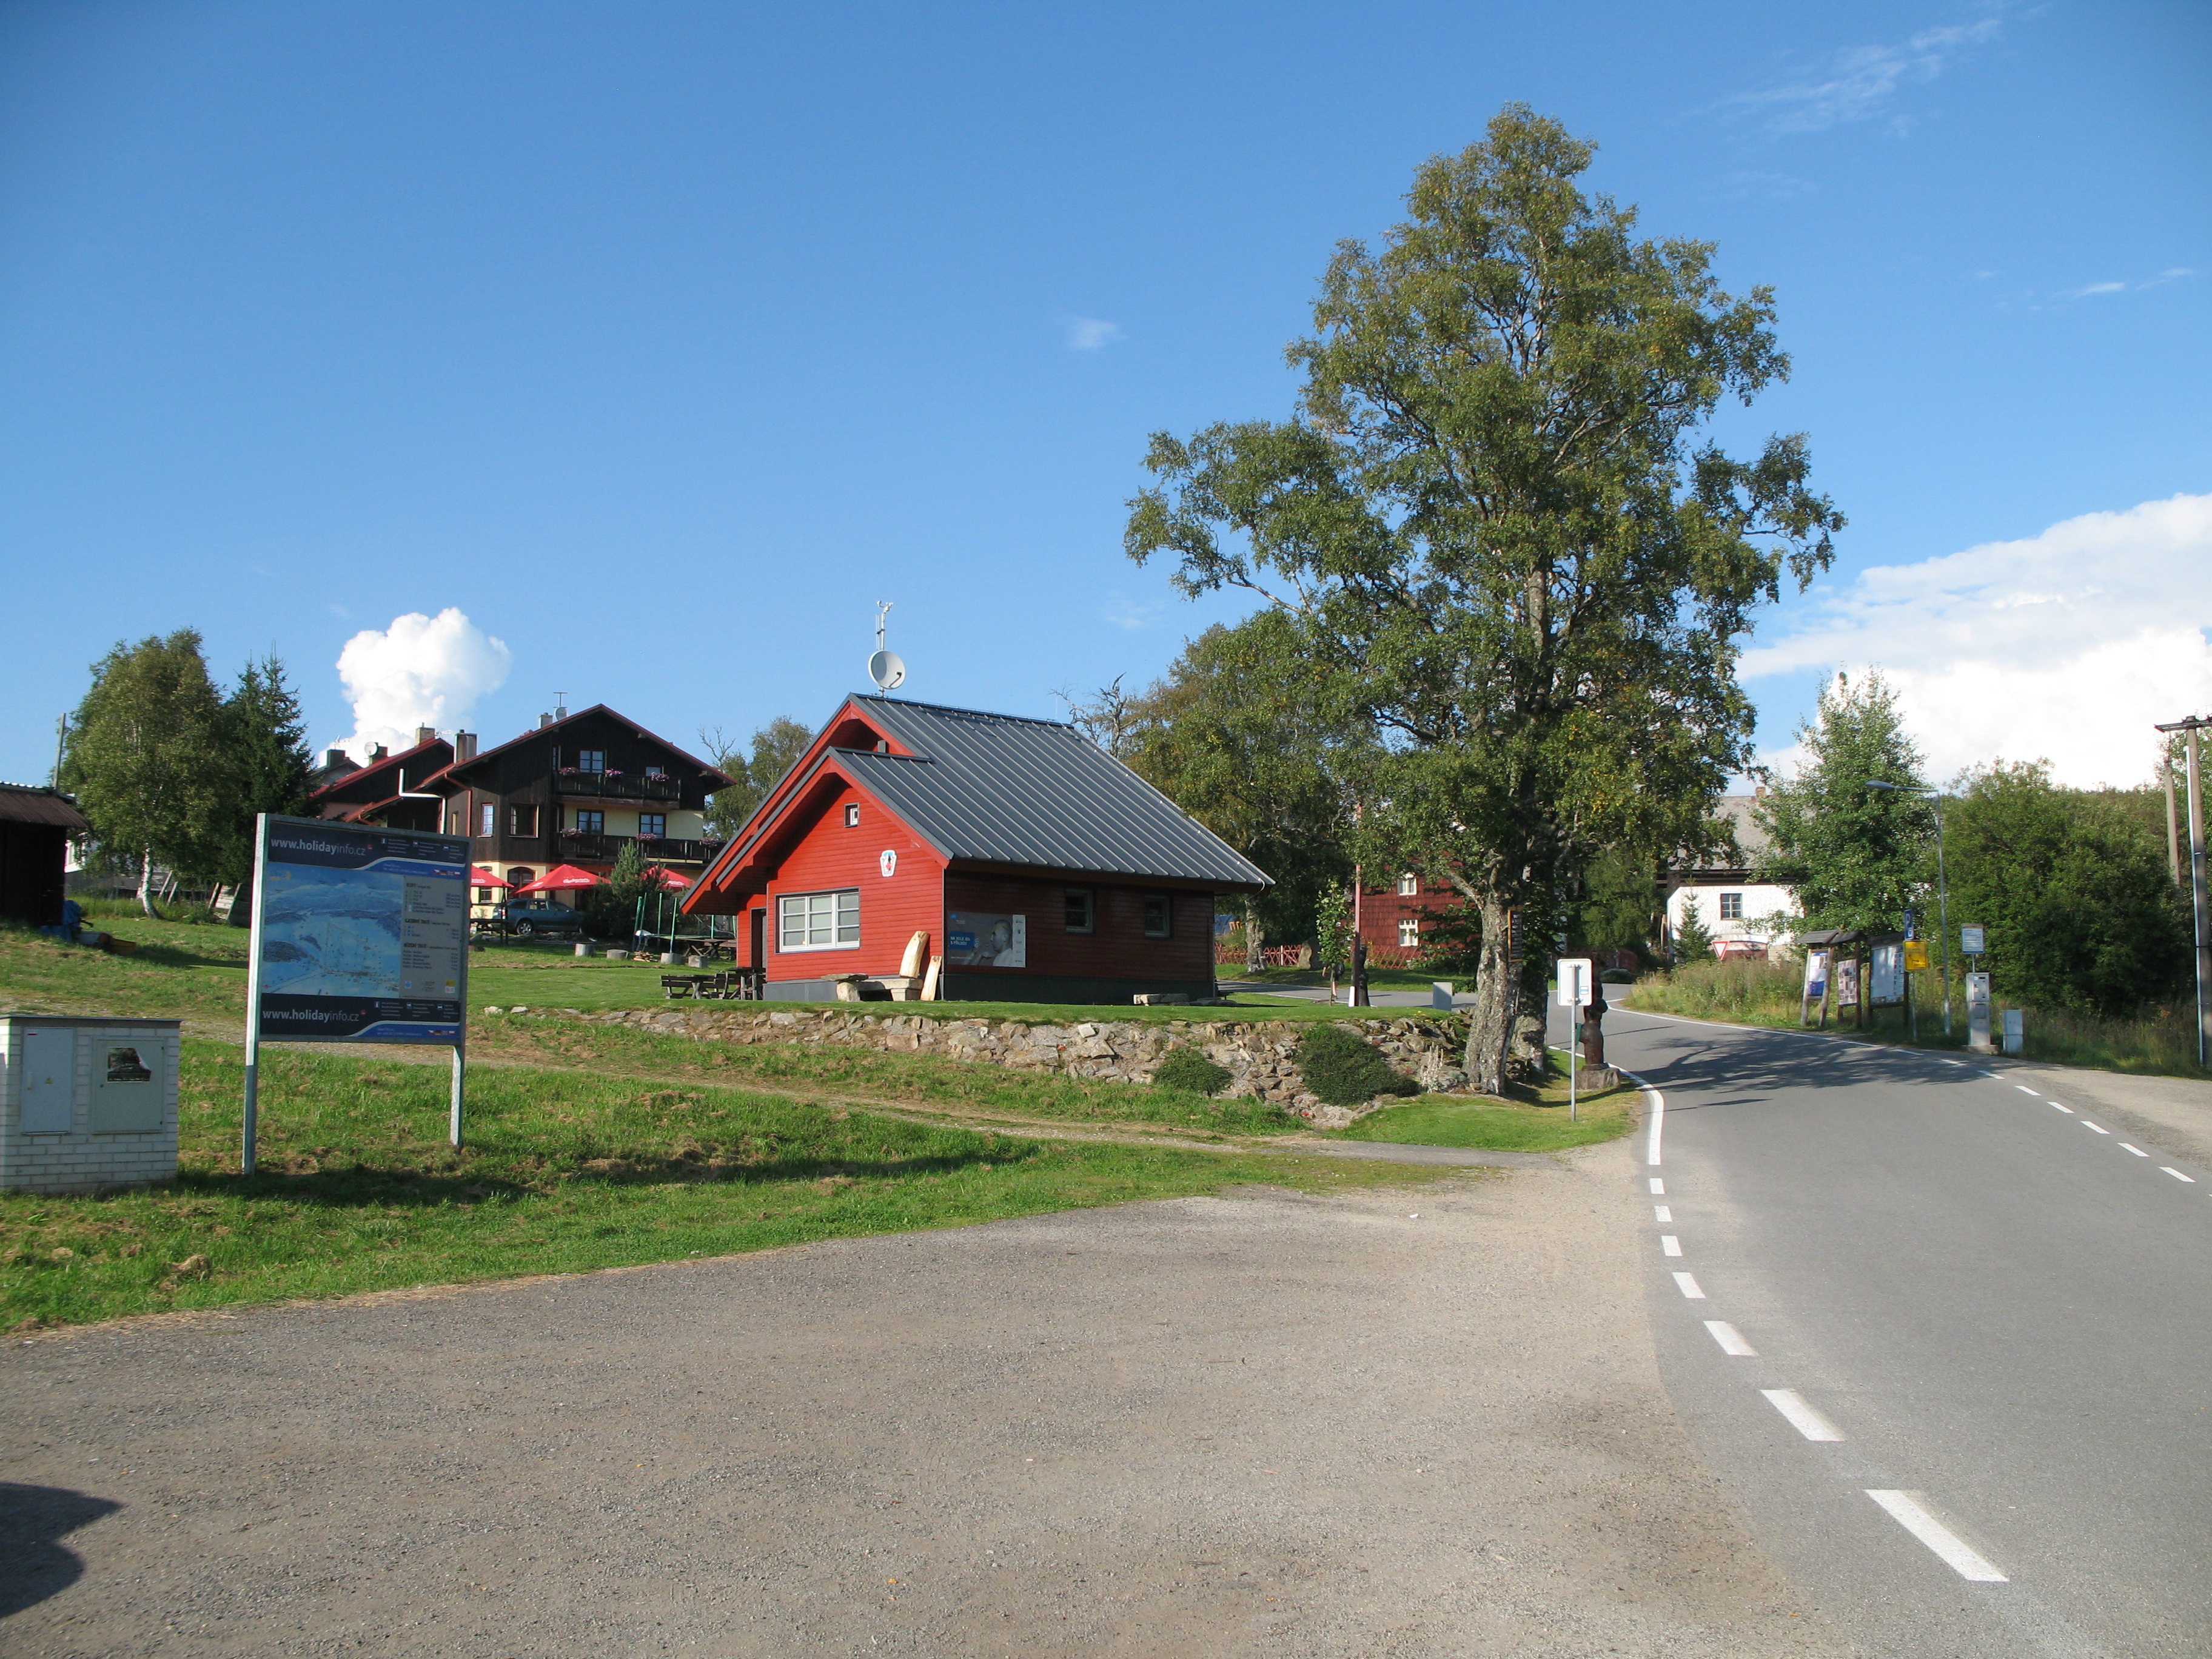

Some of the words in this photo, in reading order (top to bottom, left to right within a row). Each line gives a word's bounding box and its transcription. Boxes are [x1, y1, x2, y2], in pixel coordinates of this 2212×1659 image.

[270, 839, 366, 856] www.holidayinfo.cz
[1905, 913, 1911, 928] P
[263, 1008, 360, 1024] www.holidayinfo.cz
